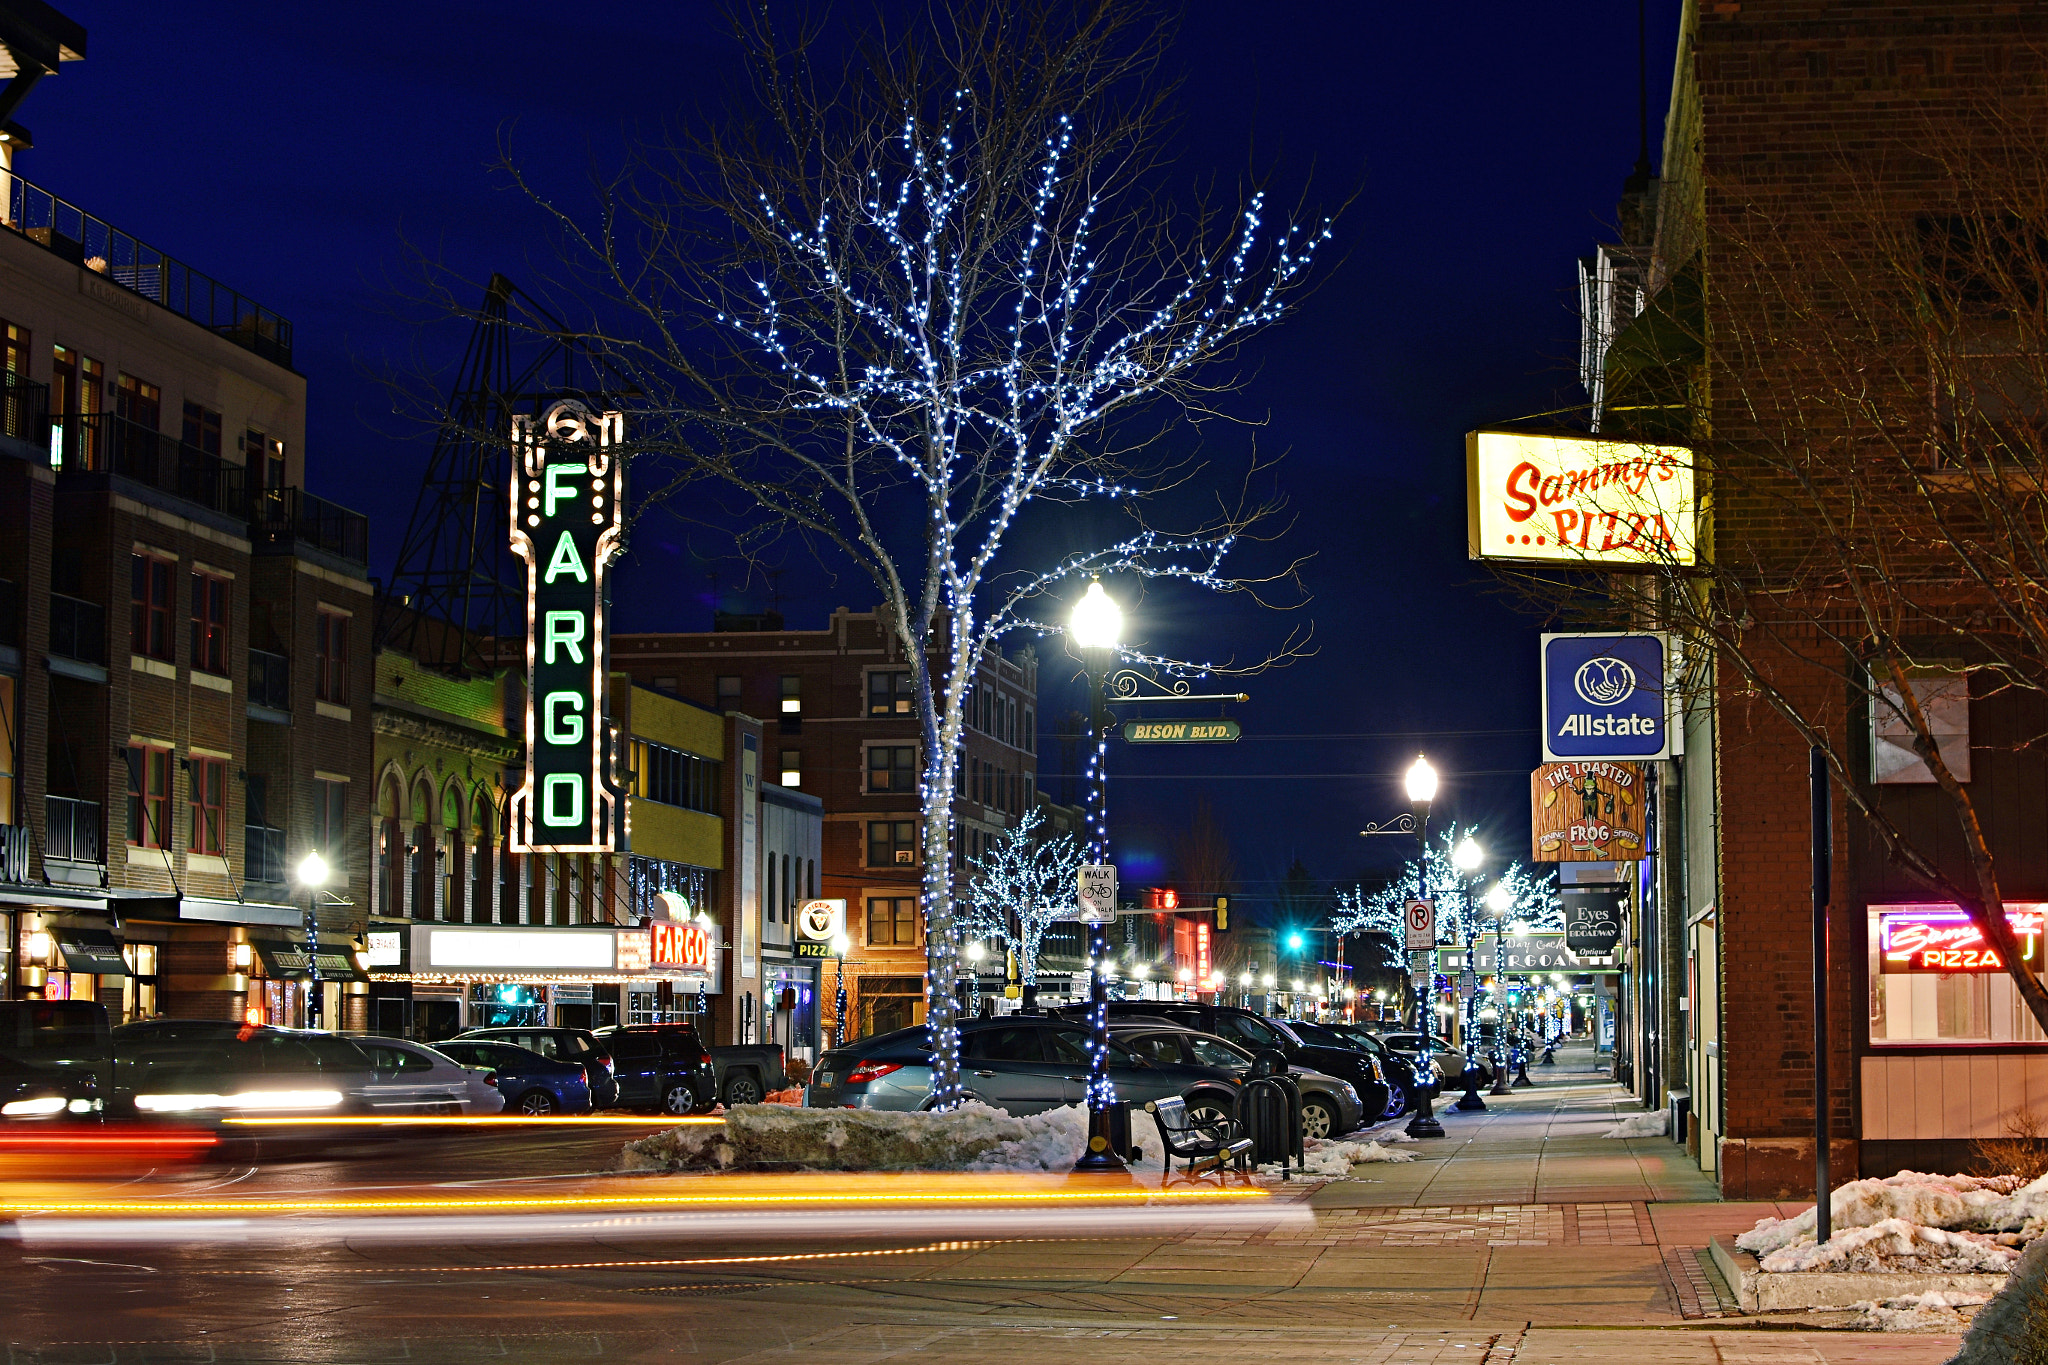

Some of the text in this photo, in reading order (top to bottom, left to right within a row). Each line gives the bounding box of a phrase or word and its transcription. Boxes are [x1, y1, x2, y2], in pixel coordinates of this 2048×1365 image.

[88, 279, 142, 315] KILBOURNE
[1504, 449, 1678, 523] Sammy's
[1549, 508, 1681, 553] PIZZA
[542, 462, 588, 829] FARGO
[1133, 724, 1231, 739] BISON BLVD.
[1557, 713, 1656, 737] Allstate
[744, 773, 755, 788] W
[1545, 762, 1633, 788] THE TOASTED
[1539, 830, 1565, 846] DINING
[1570, 825, 1610, 842] FROG
[1613, 829, 1640, 844] SPIRITS
[1084, 870, 1110, 879] WALK
[804, 902, 823, 914] SPICY
[1577, 907, 1609, 923] Eyes
[1569, 930, 1617, 938] BROADWAY
[655, 925, 706, 965] FARGO
[799, 944, 836, 956] PIZZA
[1198, 924, 1208, 977] EMPIRE
[1580, 947, 1607, 956] Optique
[1924, 950, 2001, 967] PIZZA
